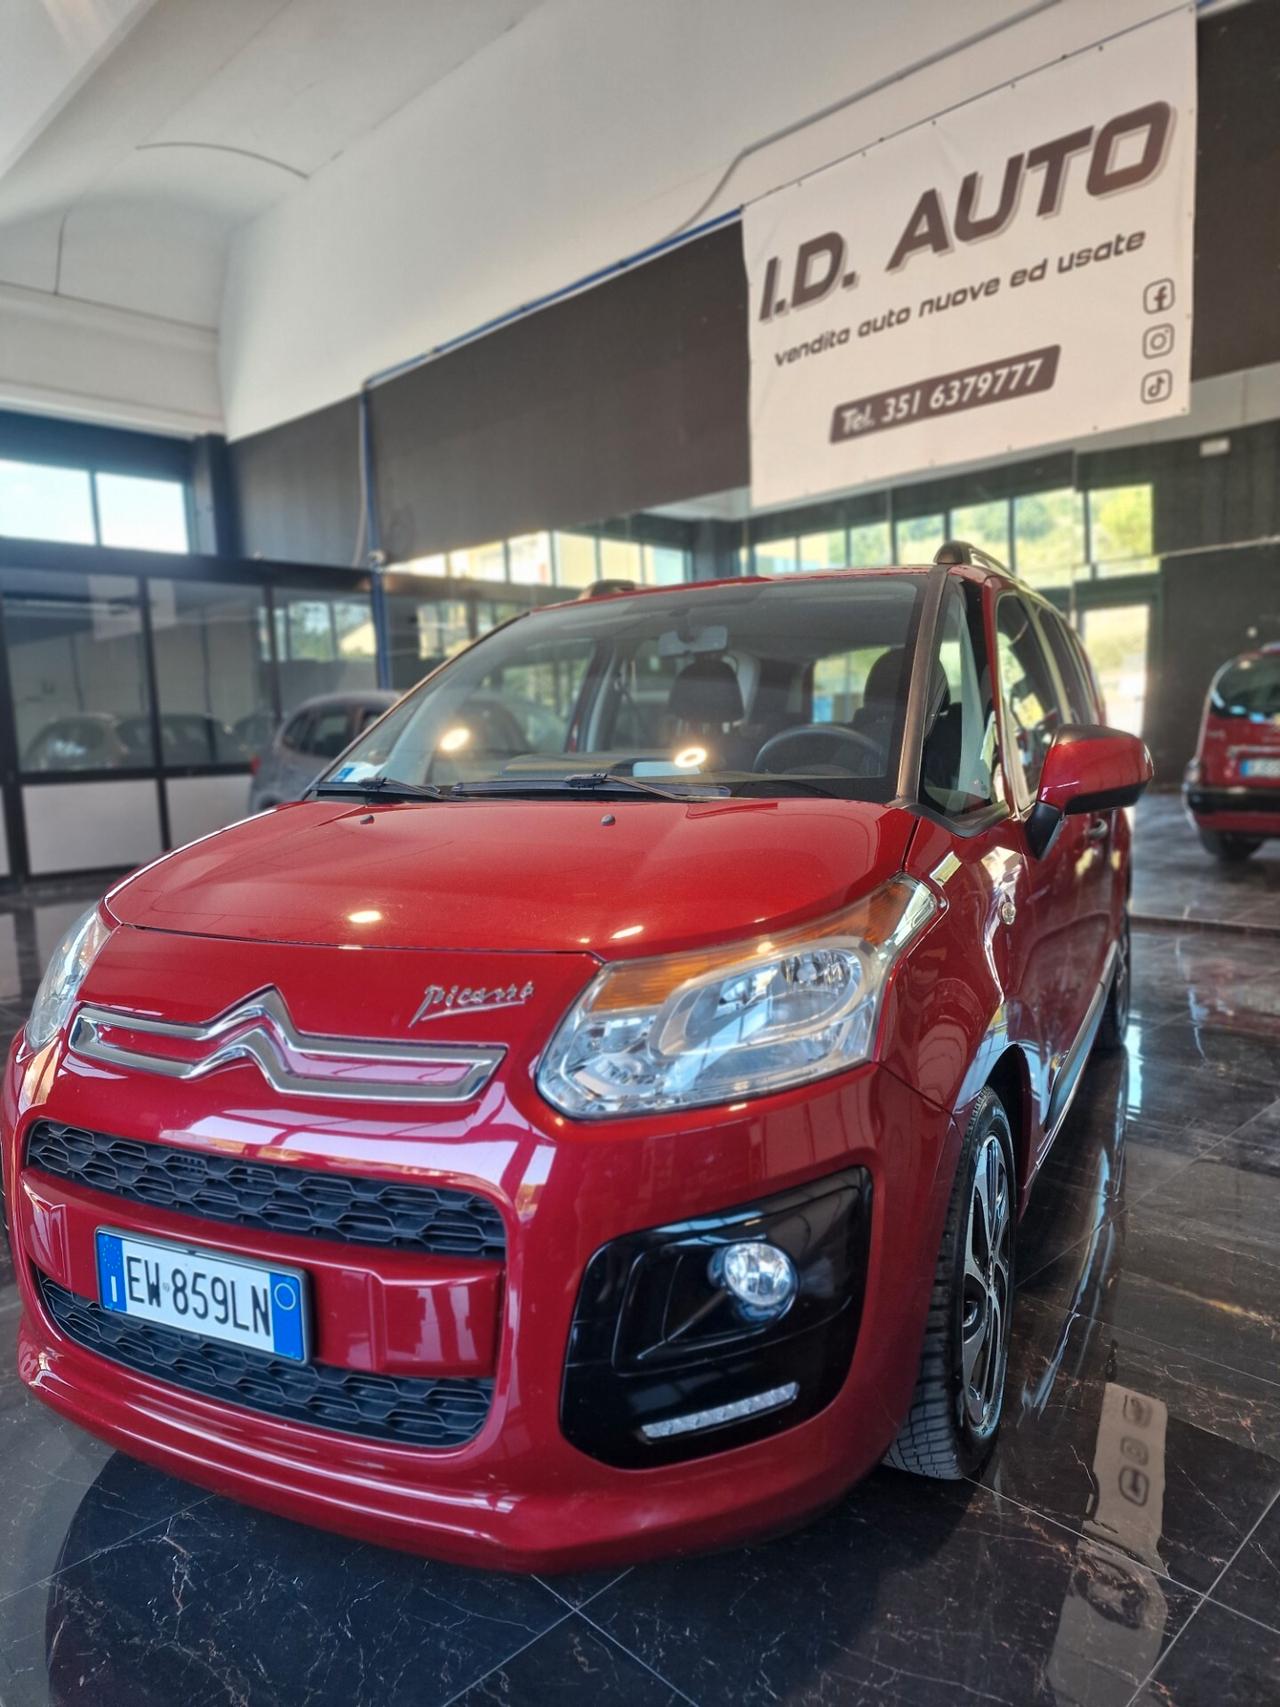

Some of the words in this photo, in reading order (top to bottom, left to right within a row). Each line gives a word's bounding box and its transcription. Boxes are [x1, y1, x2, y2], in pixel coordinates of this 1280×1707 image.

[758, 231, 859, 323] I.D.
[885, 101, 1175, 273] AUTO
[774, 327, 851, 367] vendita
[857, 307, 911, 338] auto
[918, 277, 1000, 318] nuove
[1009, 258, 1048, 288] ed
[1057, 231, 1146, 274] usate
[841, 403, 876, 434] Tel.
[881, 389, 922, 423] 351
[929, 358, 1044, 409] 6379777
